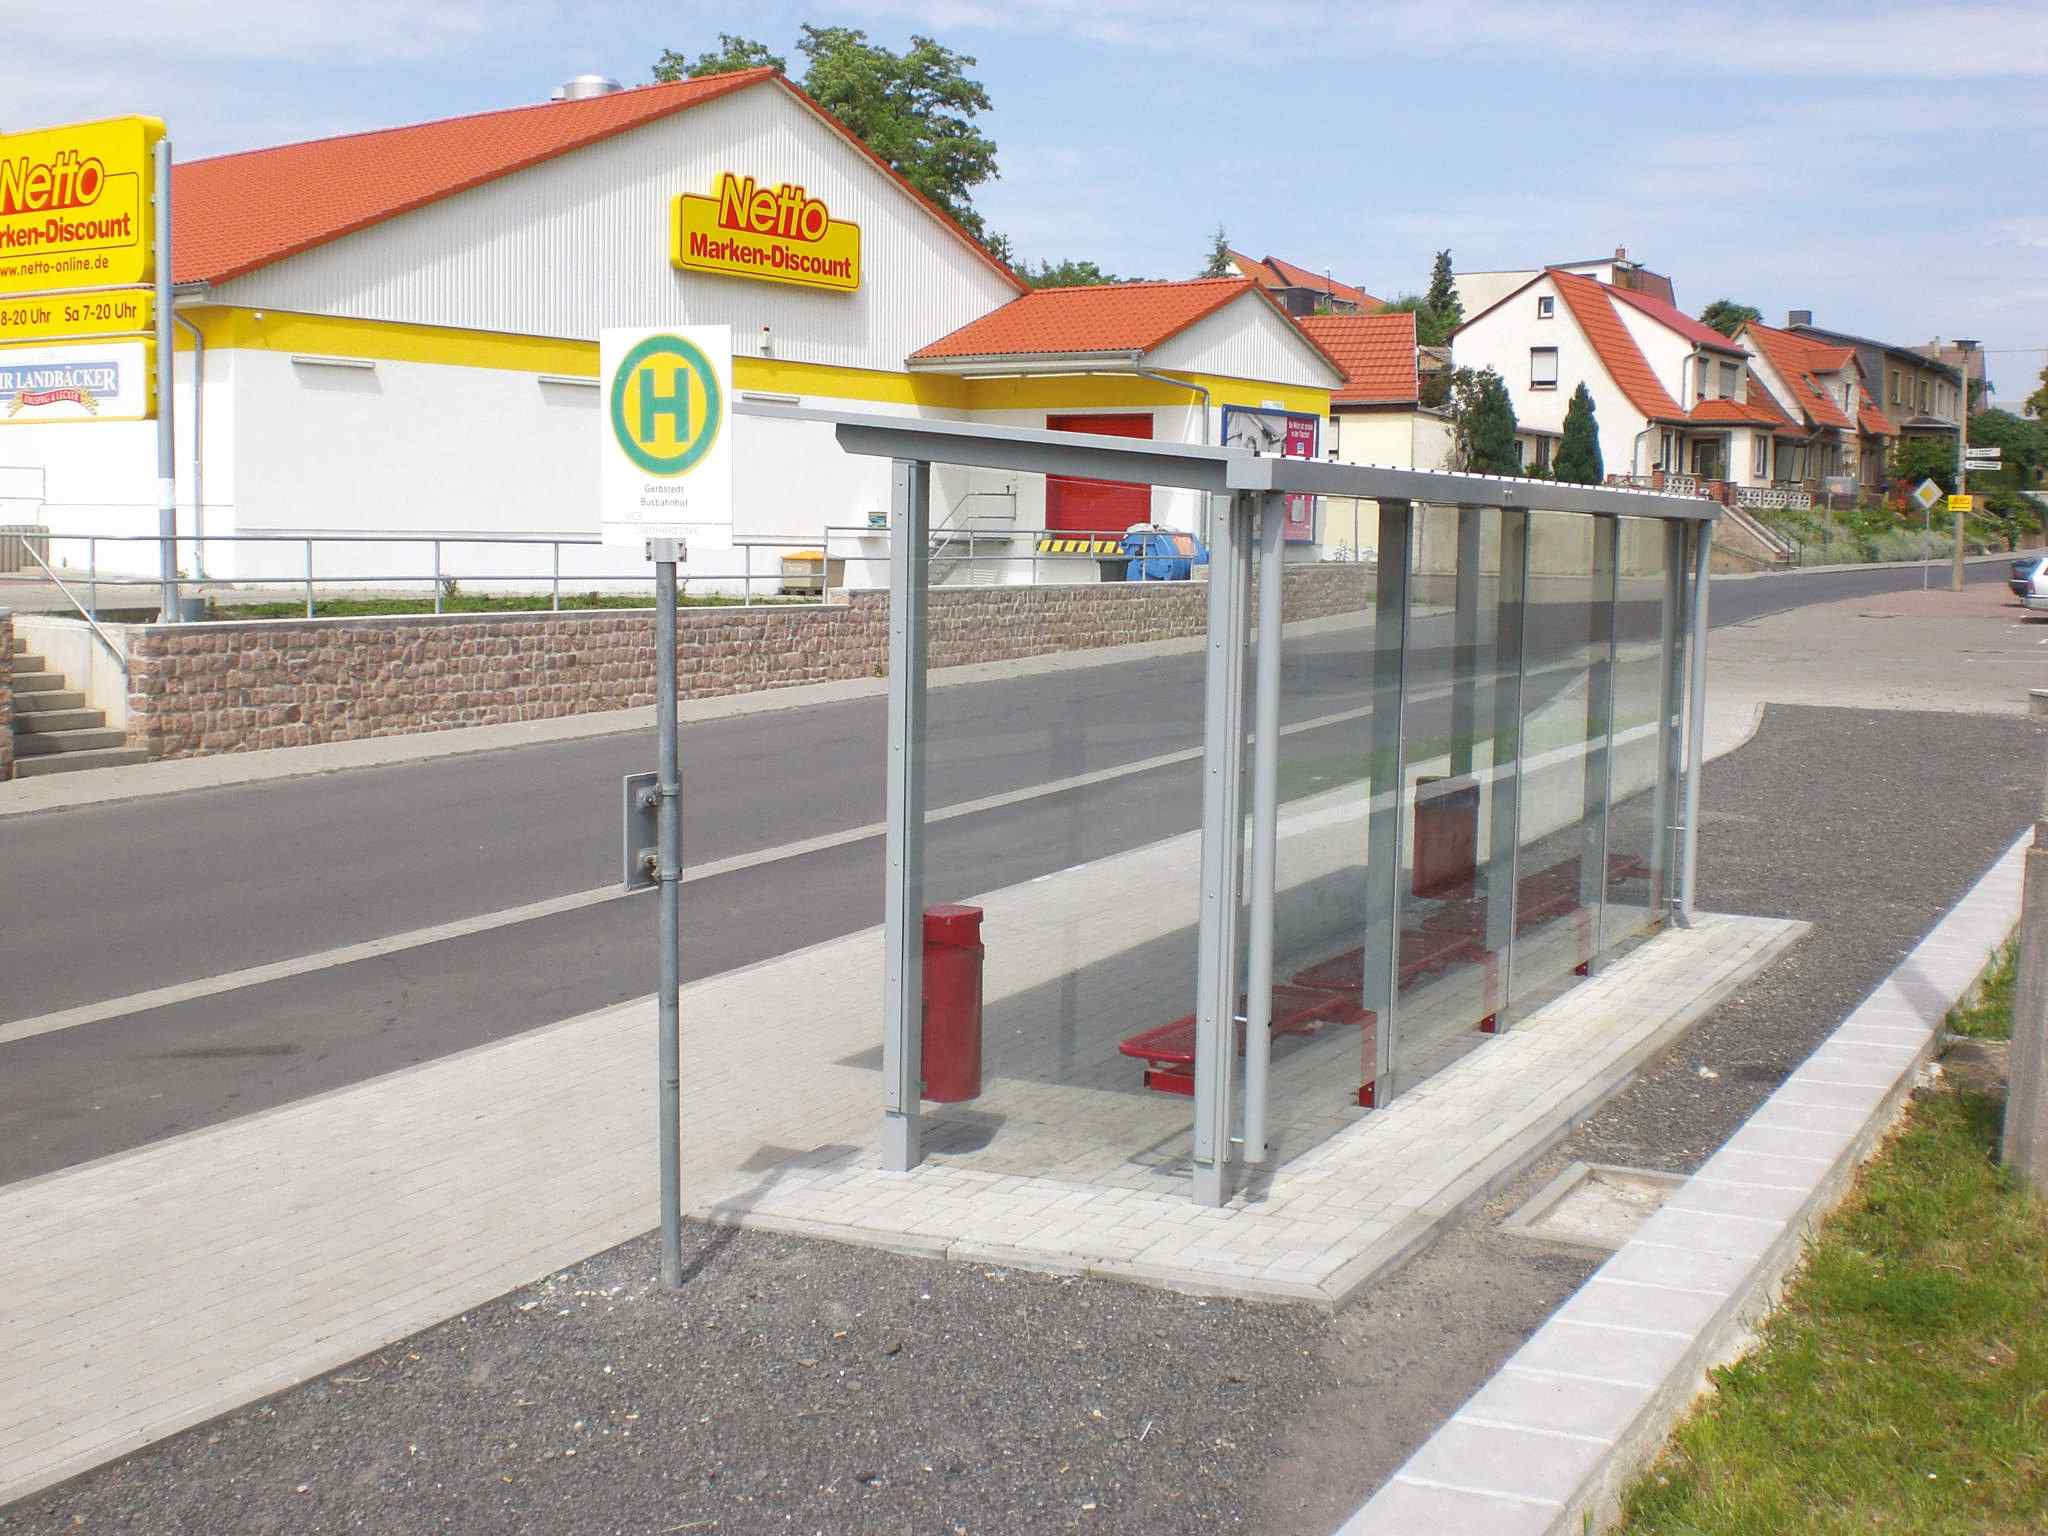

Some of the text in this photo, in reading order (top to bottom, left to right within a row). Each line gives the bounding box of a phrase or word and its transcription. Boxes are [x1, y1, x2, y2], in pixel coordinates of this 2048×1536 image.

[0, 149, 105, 215] Netto
[718, 172, 828, 242] Netto
[689, 231, 852, 279] Marken-Discount
[30, 307, 51, 324] Uhr
[64, 306, 79, 322] Sa
[83, 303, 111, 321] 7-20
[115, 300, 137, 319] Uhr
[16, 365, 116, 391] LANDBÄCKER
[640, 367, 689, 443] H
